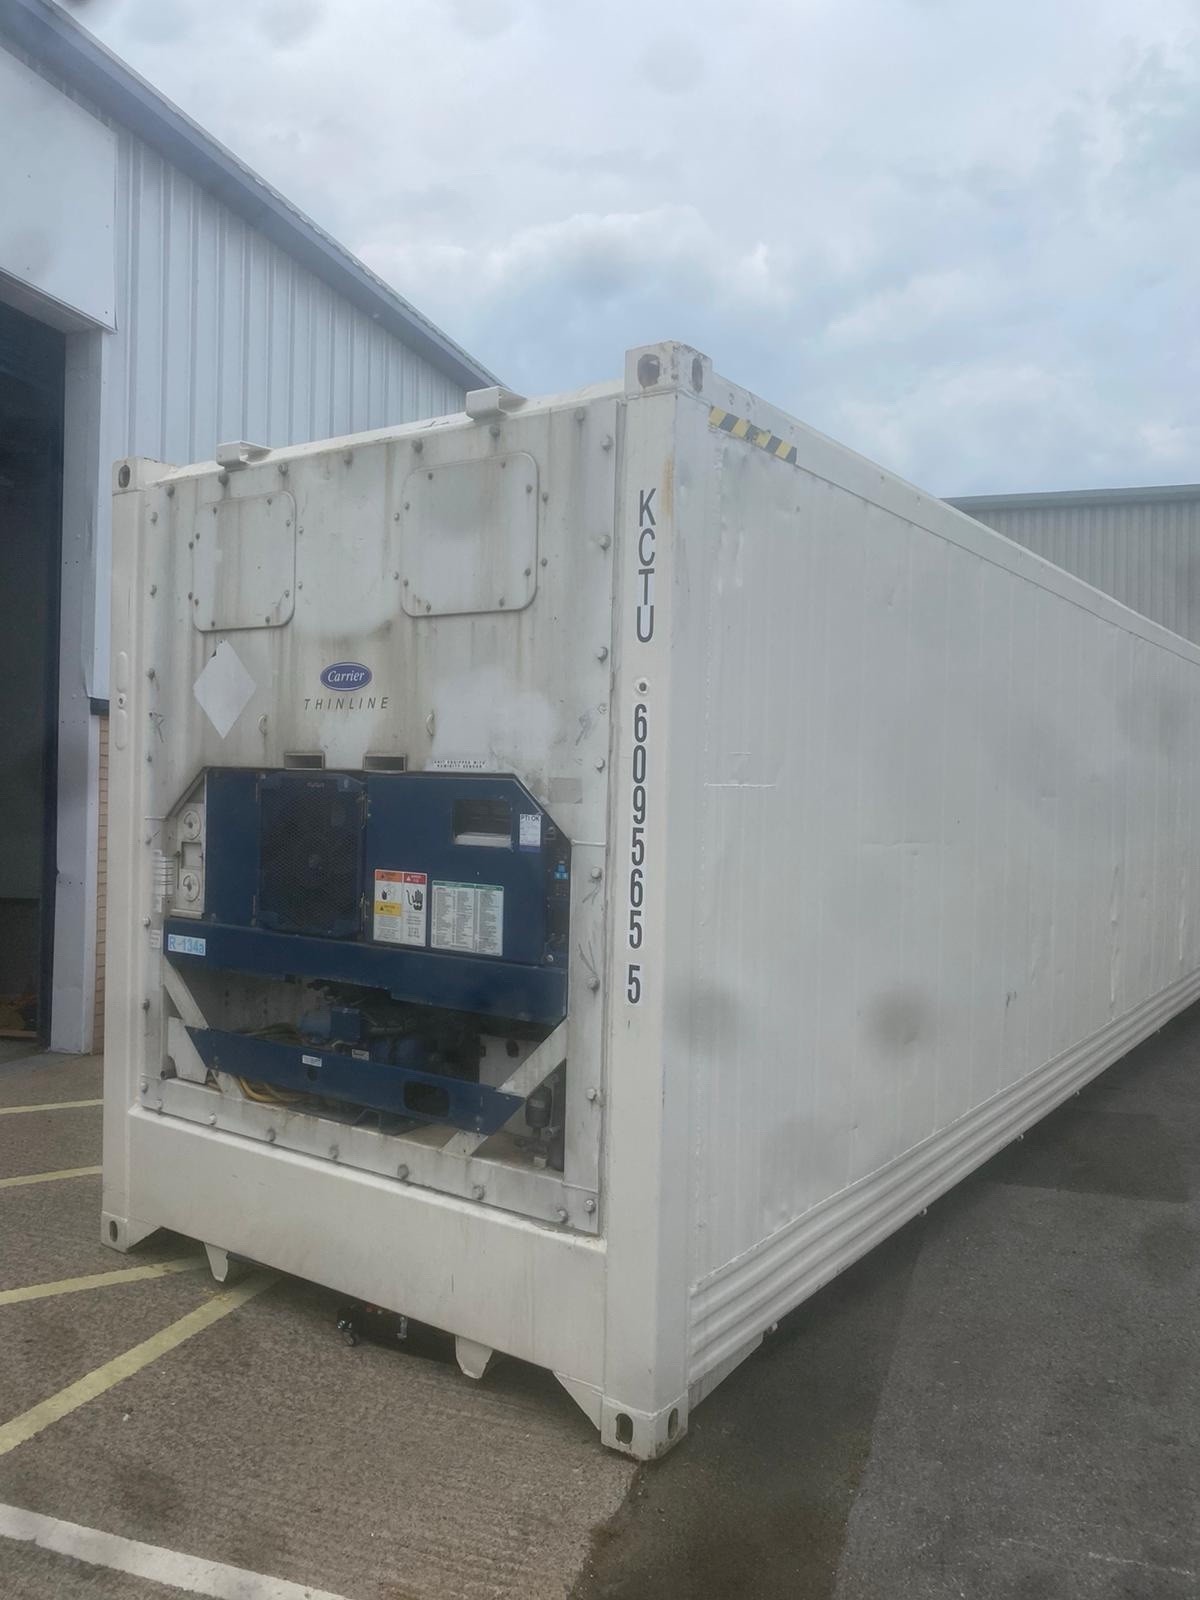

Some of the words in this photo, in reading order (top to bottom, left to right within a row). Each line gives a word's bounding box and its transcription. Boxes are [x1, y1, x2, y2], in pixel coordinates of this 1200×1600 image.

[636, 487, 657, 643] KCTU
[327, 669, 365, 683] Carrier
[304, 696, 389, 710] THINLINE
[629, 703, 648, 949] 609565
[627, 963, 642, 1004] 5
